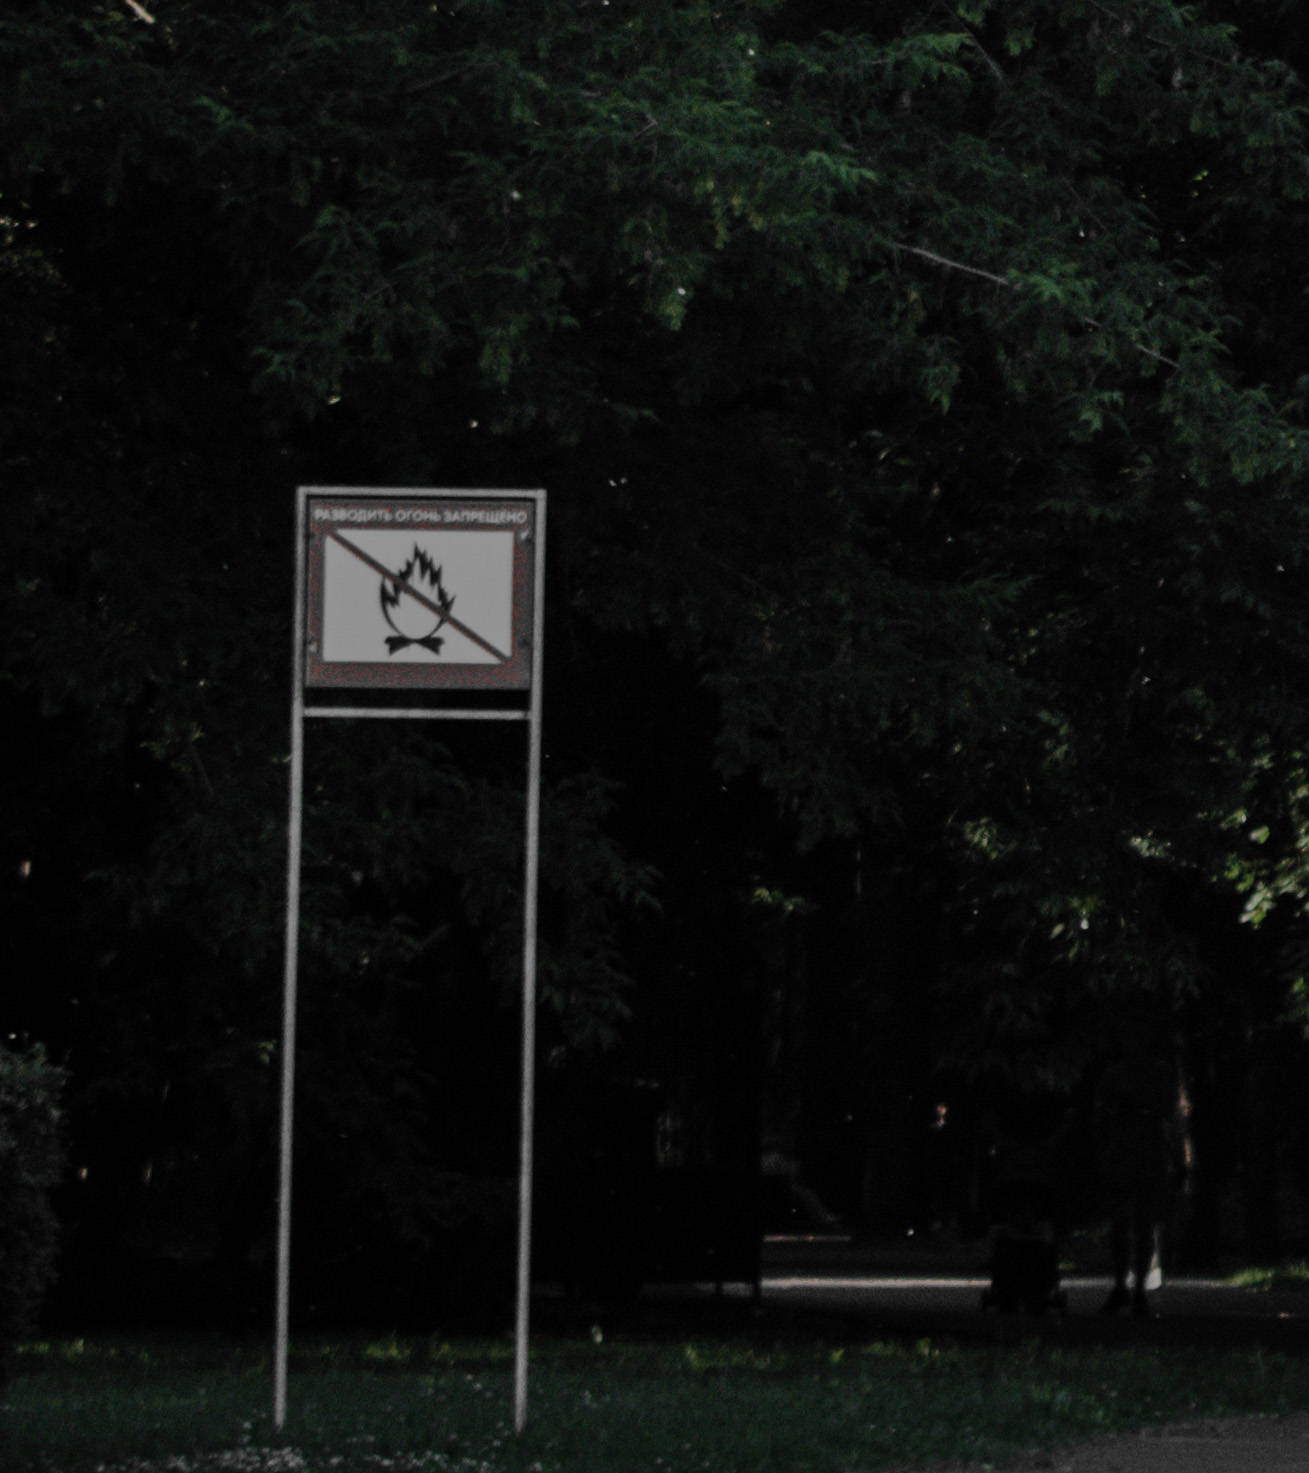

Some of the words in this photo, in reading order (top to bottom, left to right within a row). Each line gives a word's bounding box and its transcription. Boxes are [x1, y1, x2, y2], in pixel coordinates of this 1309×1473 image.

[314, 509, 392, 522] РАЗВОДИТЬ
[395, 510, 441, 522] ОГОНЬ
[443, 510, 527, 523] ЗАПРЕЩЕНО
